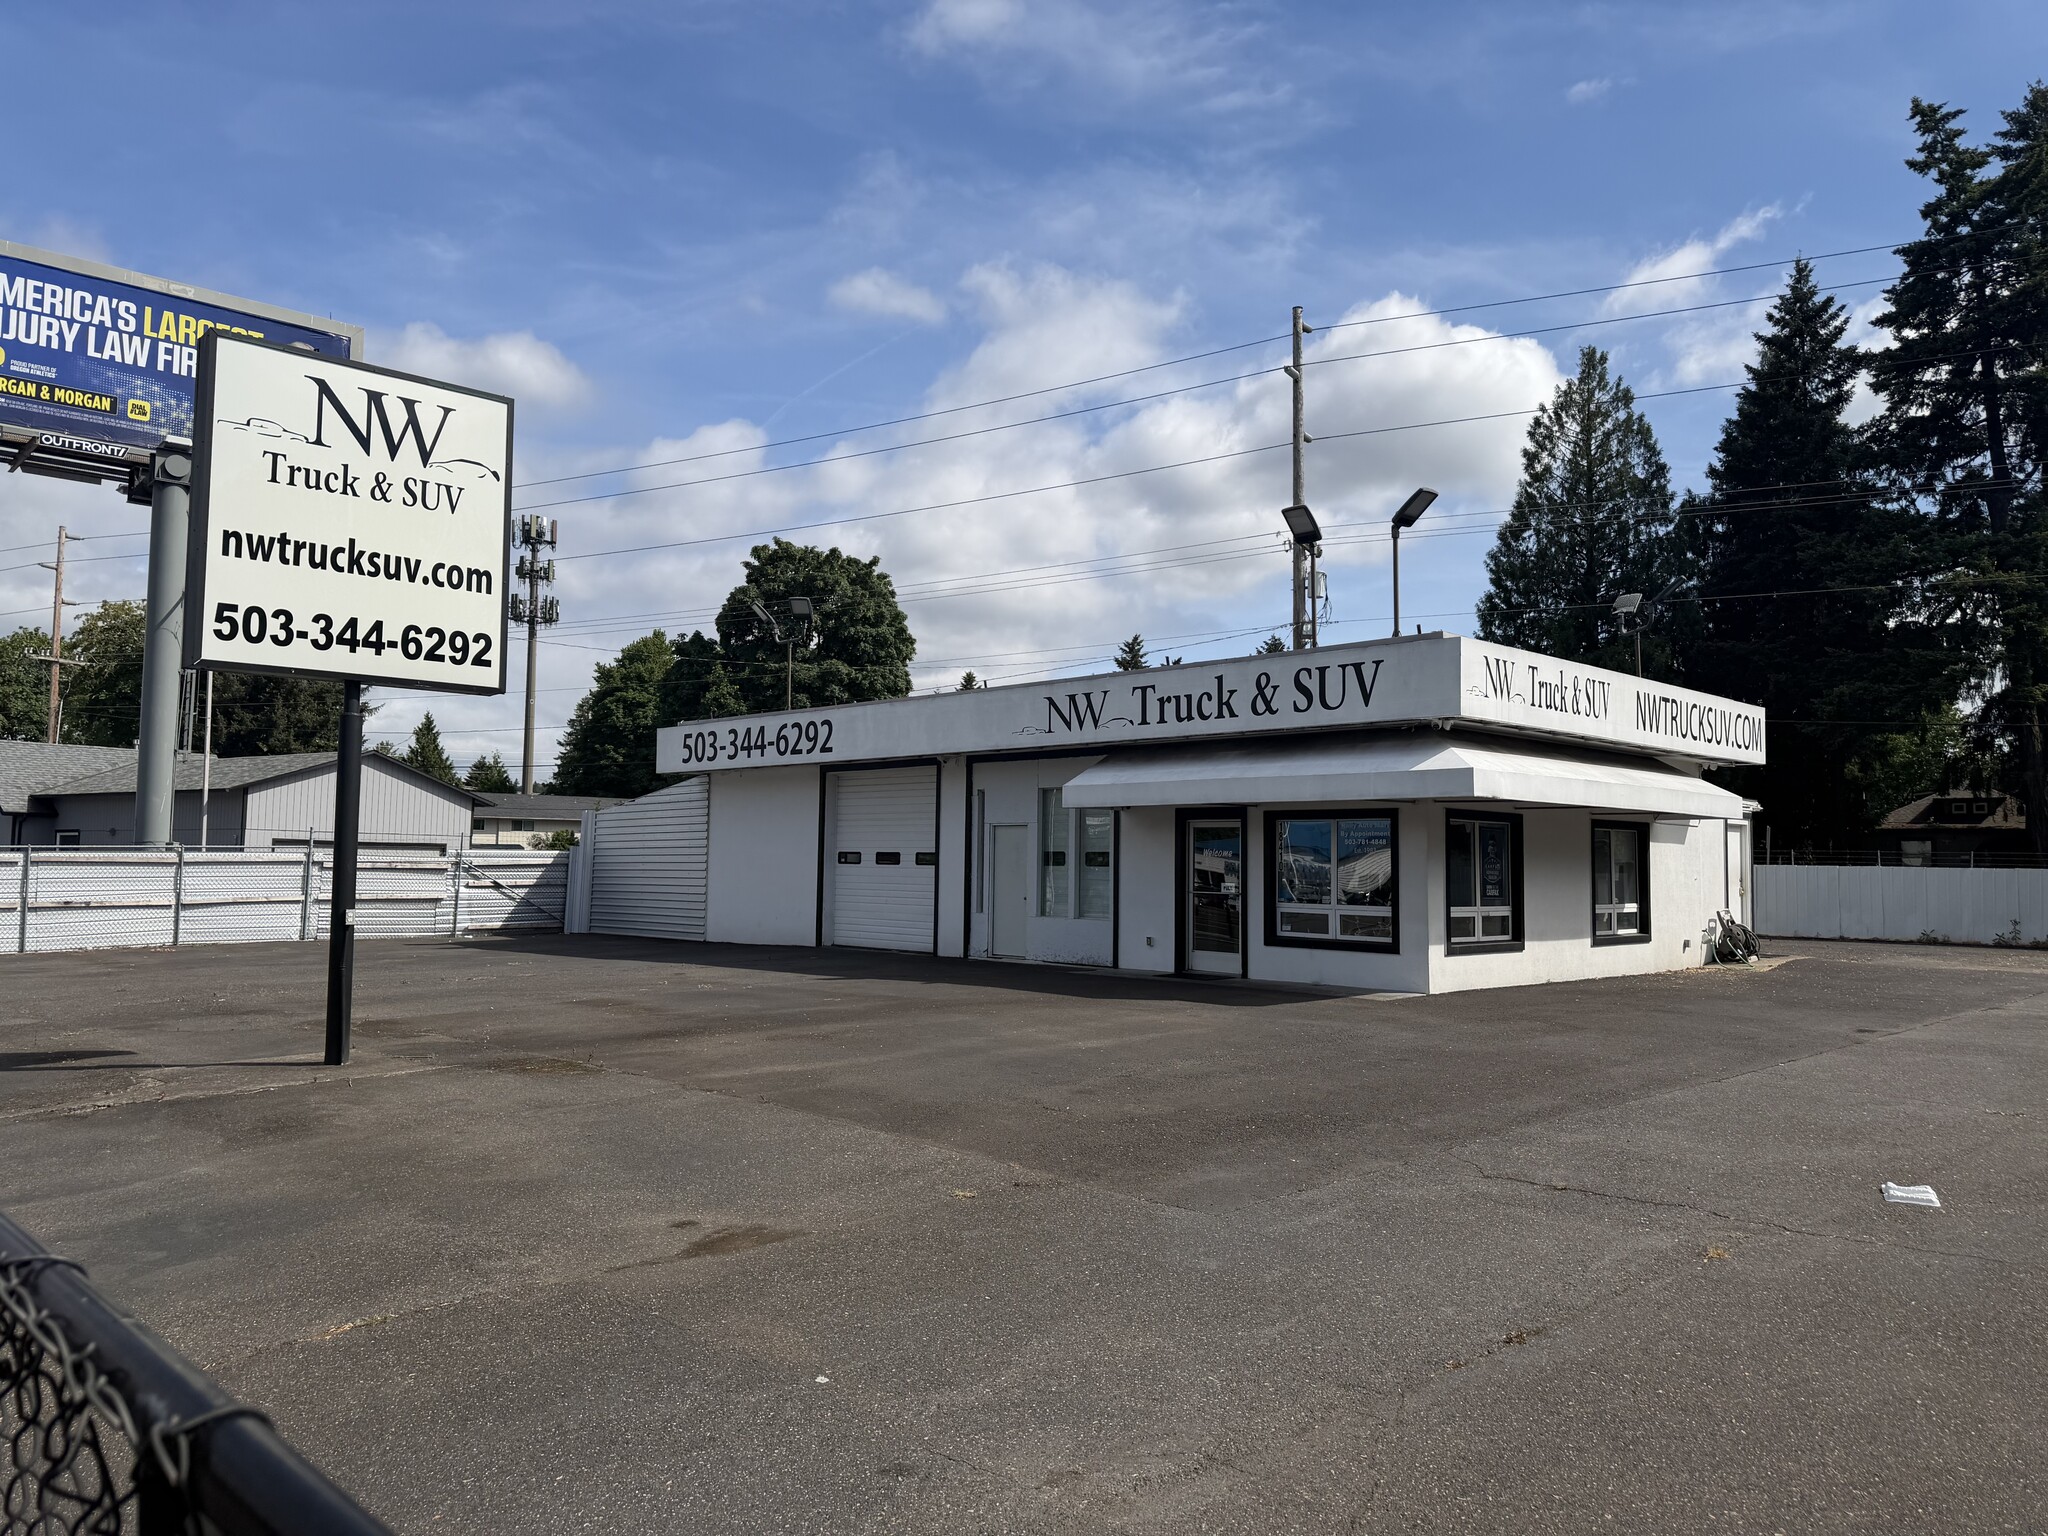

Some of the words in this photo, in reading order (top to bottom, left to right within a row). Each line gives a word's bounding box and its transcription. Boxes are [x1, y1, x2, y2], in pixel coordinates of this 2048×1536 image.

[0, 272, 137, 333] MERICA'S
[0, 307, 81, 353] JURY
[87, 326, 151, 368] LAW
[157, 341, 197, 379] FIR
[0, 377, 37, 398] RGAN
[40, 385, 50, 400] &
[54, 387, 111, 412] MORGAN
[131, 403, 146, 411] DIAL
[304, 375, 456, 468] NW
[262, 450, 361, 498] Truck
[370, 471, 393, 503] &
[402, 476, 465, 515] SUV
[221, 529, 493, 595] nwtrucksuv.com
[213, 602, 493, 668] 503-344-6292
[1043, 690, 1111, 733] NW
[1132, 674, 1239, 726] Truck
[1251, 671, 1280, 717] &
[1293, 659, 1385, 713] SUV
[1483, 655, 1516, 702] NW
[1528, 665, 1569, 713] Truck
[1572, 675, 1582, 716] &
[1585, 677, 1611, 720] SUV
[682, 719, 834, 764] 503-344-6292
[1636, 690, 1763, 753] NWTRUCKSUV.COM
[1203, 848, 1233, 858] Welcome
[1340, 830, 1348, 838] By
[1350, 830, 1391, 838] Appointment
